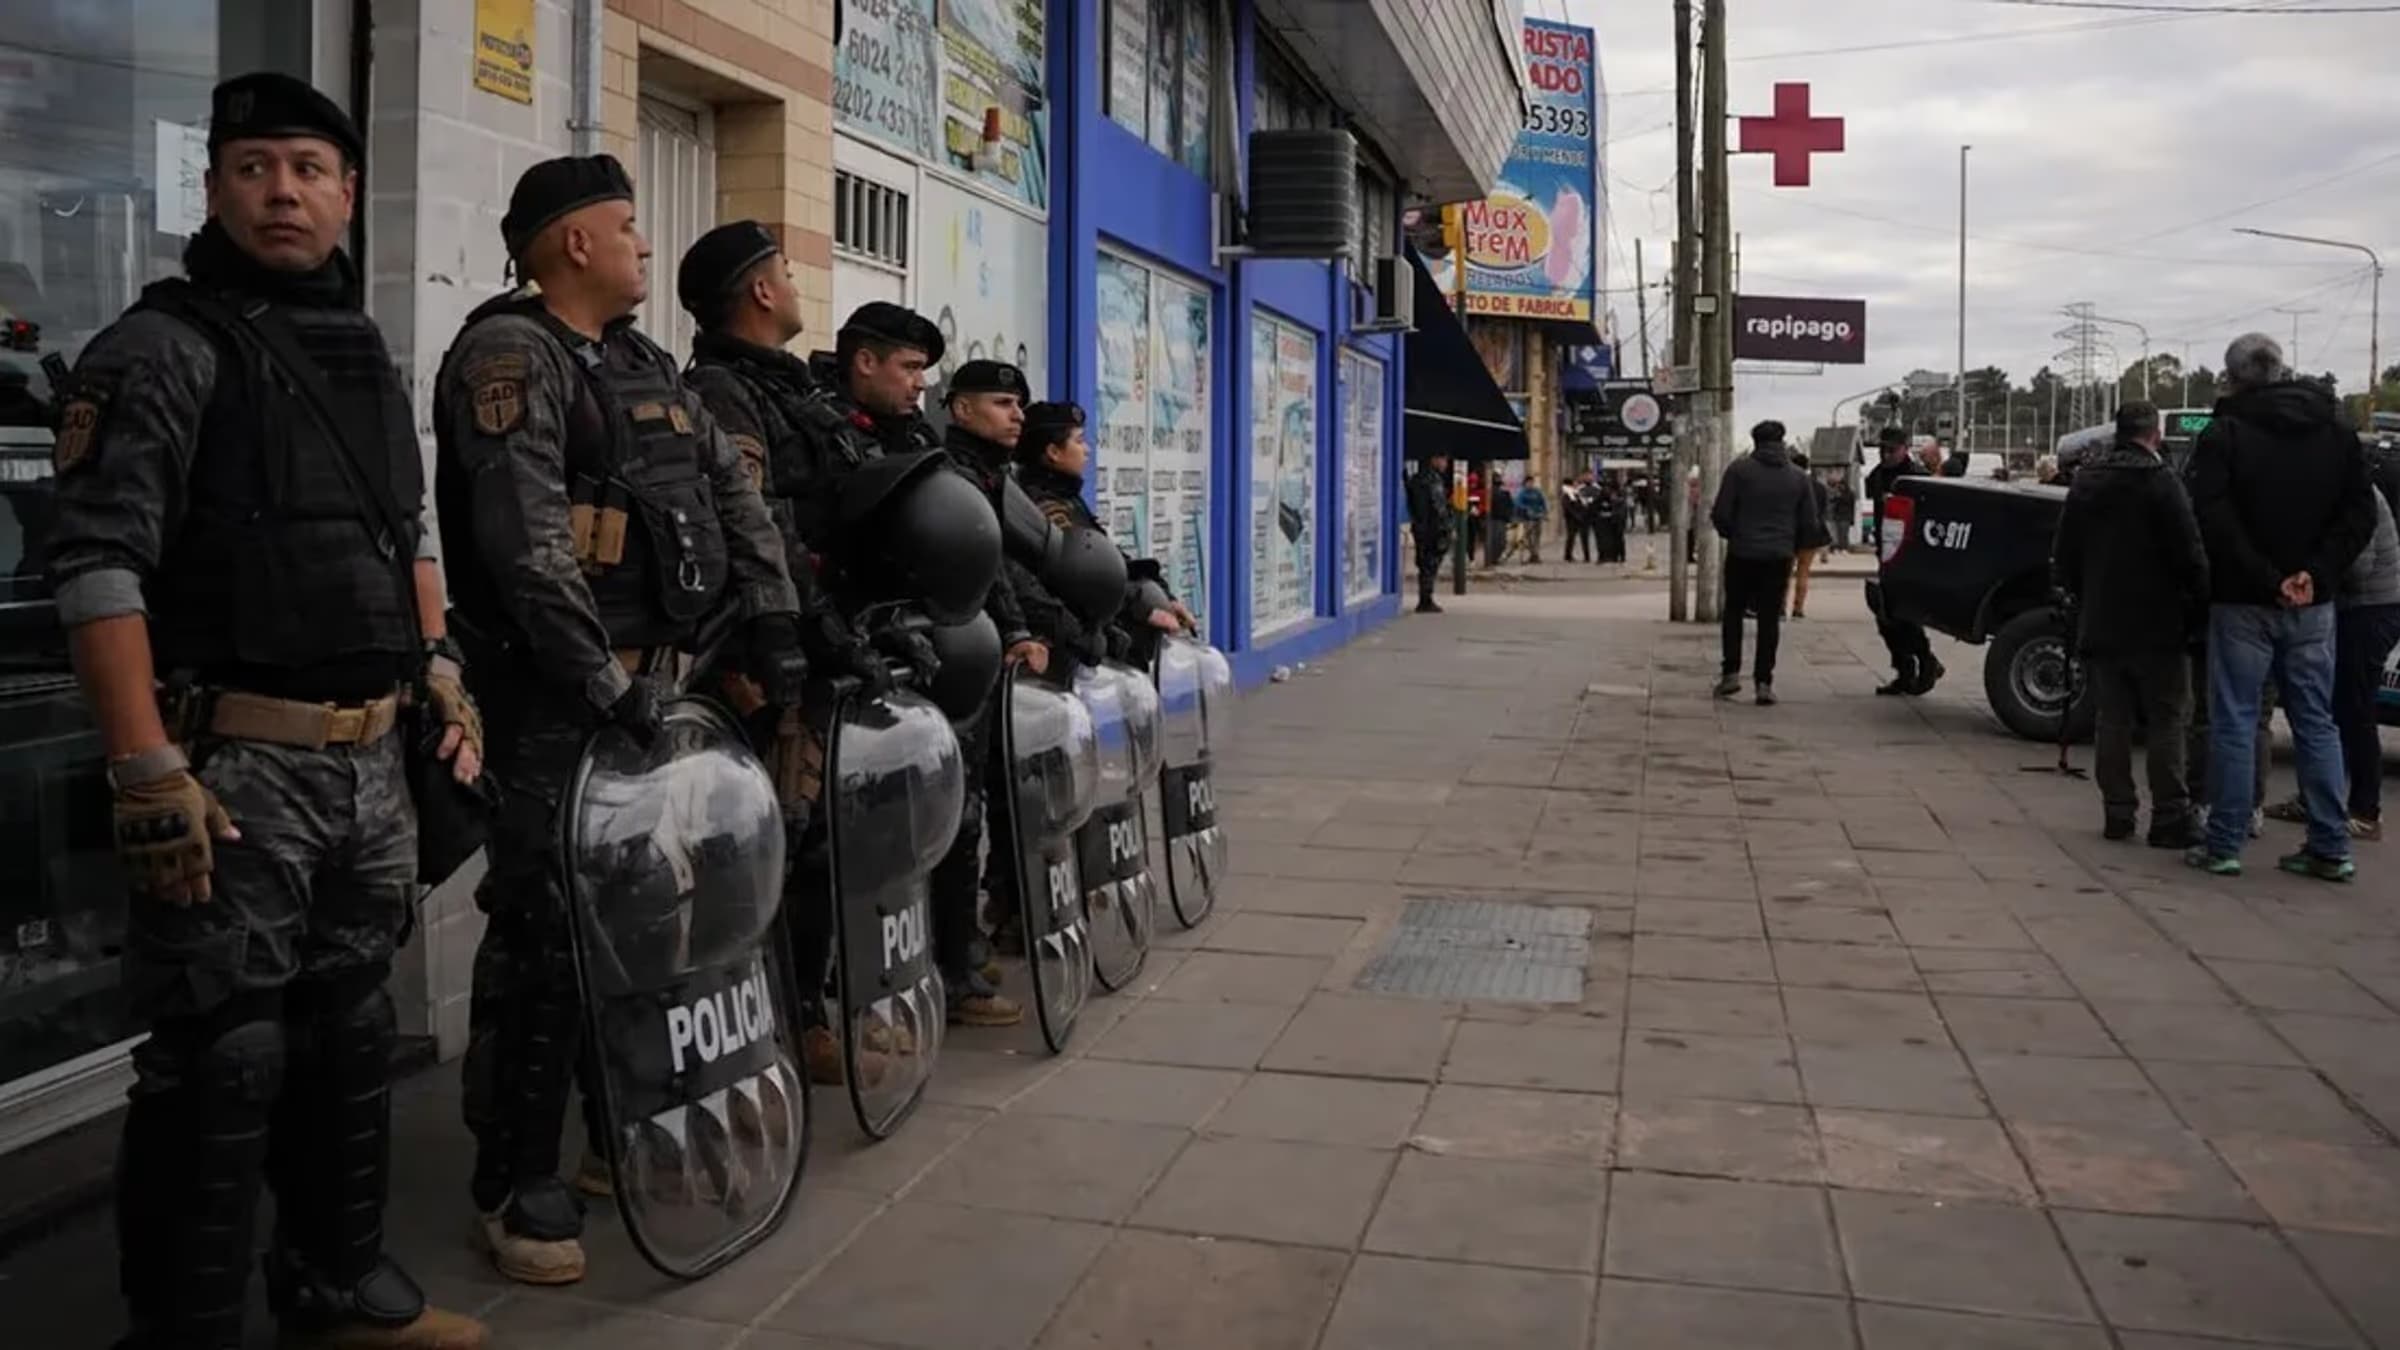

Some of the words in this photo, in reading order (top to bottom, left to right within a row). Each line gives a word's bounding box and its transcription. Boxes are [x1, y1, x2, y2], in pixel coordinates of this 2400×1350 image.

[849, 28, 891, 81] 6024
[1466, 198, 1528, 231] Max
[1491, 295, 1511, 313] DE
[1518, 297, 1577, 317] FABRICA
[1746, 313, 1851, 342] rapipago
[1944, 520, 1973, 550] 911
